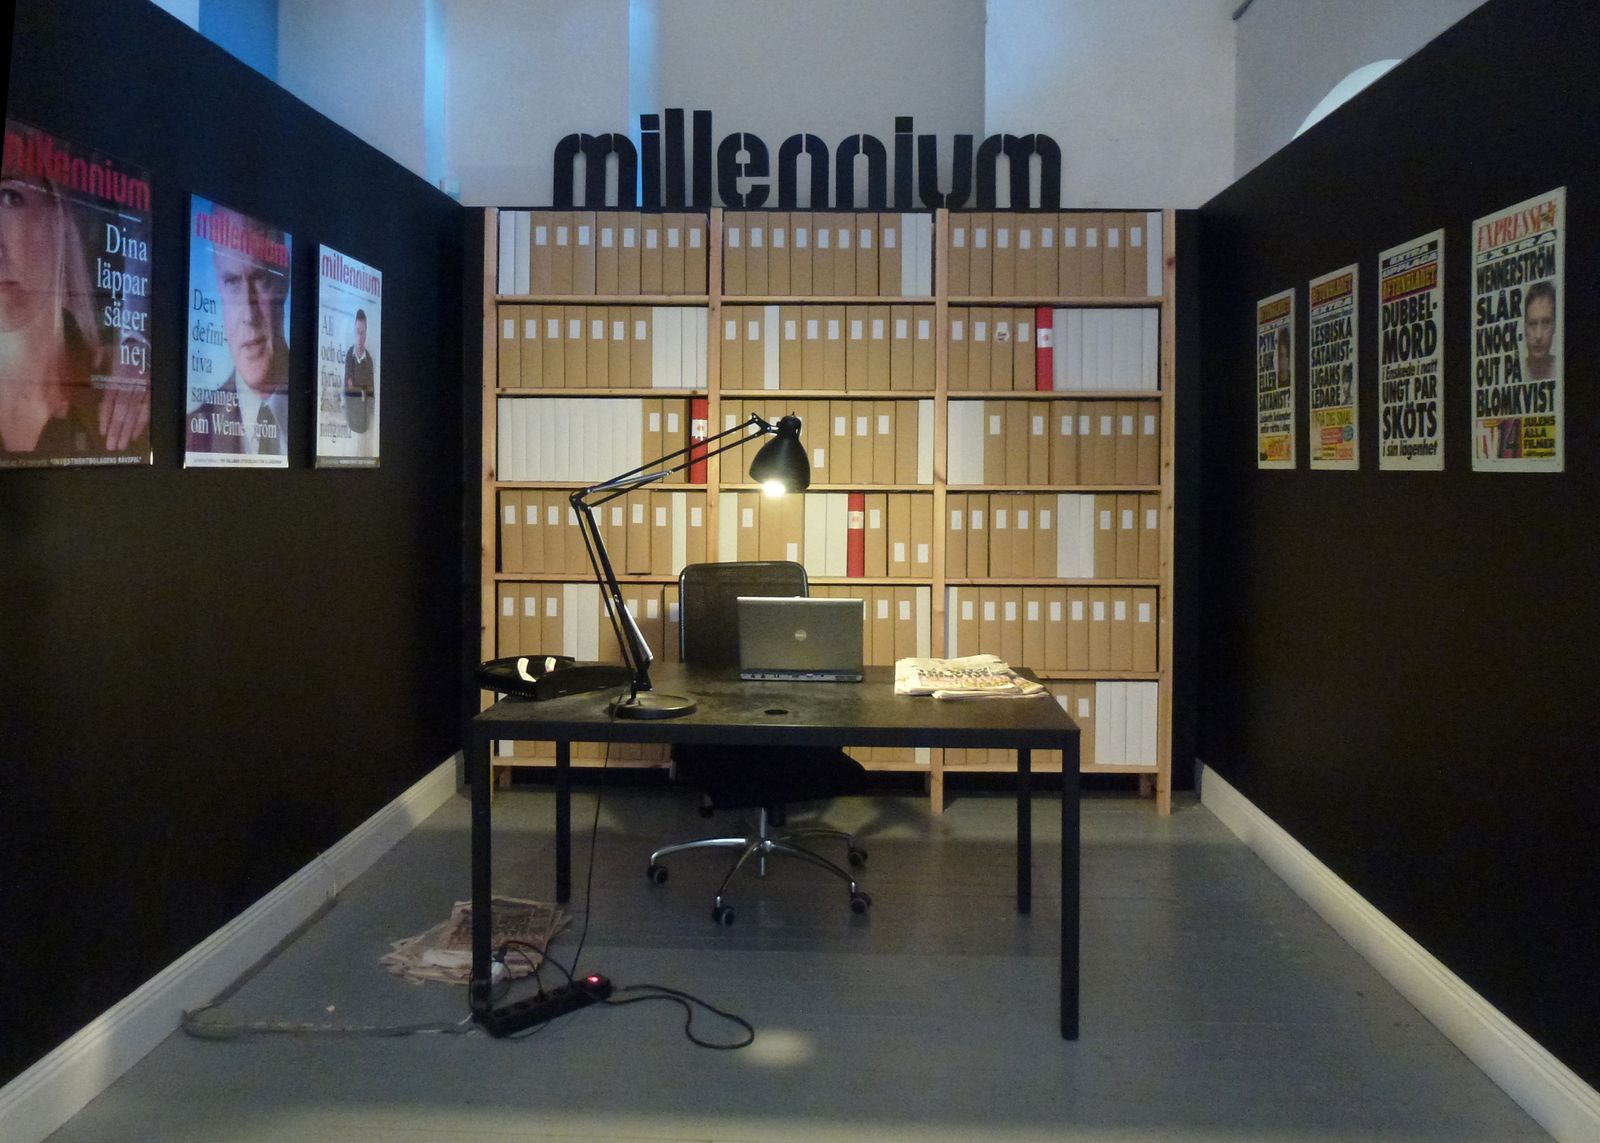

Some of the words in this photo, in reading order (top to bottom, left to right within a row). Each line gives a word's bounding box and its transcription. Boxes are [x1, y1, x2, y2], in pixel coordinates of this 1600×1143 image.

[553, 108, 1062, 208] millennium
[105, 223, 148, 262] Dina
[97, 257, 148, 301] läppar
[321, 252, 381, 298] millennium
[1477, 244, 1557, 296] WENNERSTRÖM
[104, 301, 148, 338] säger
[193, 288, 217, 315] Den
[1382, 291, 1438, 332] DUBBEL-
[1477, 288, 1523, 327] SLÅR
[192, 319, 228, 347] defini-
[1311, 317, 1353, 348] LESBISKA
[1382, 319, 1438, 366] MORD
[1476, 320, 1523, 357] KNOCK-
[120, 338, 146, 375] nej
[191, 349, 213, 374] tiva
[1311, 340, 1353, 368] SATANIST-
[1476, 357, 1501, 388] OUT
[1311, 364, 1341, 390] LIGANS
[1382, 378, 1411, 405] UNGT
[1414, 374, 1438, 400] PAR
[191, 384, 240, 413] sanninge
[1311, 386, 1341, 409] LEDARE
[1476, 380, 1556, 418] BLOMKVIST
[190, 416, 209, 434] om
[1382, 401, 1438, 440] SKÖTS
